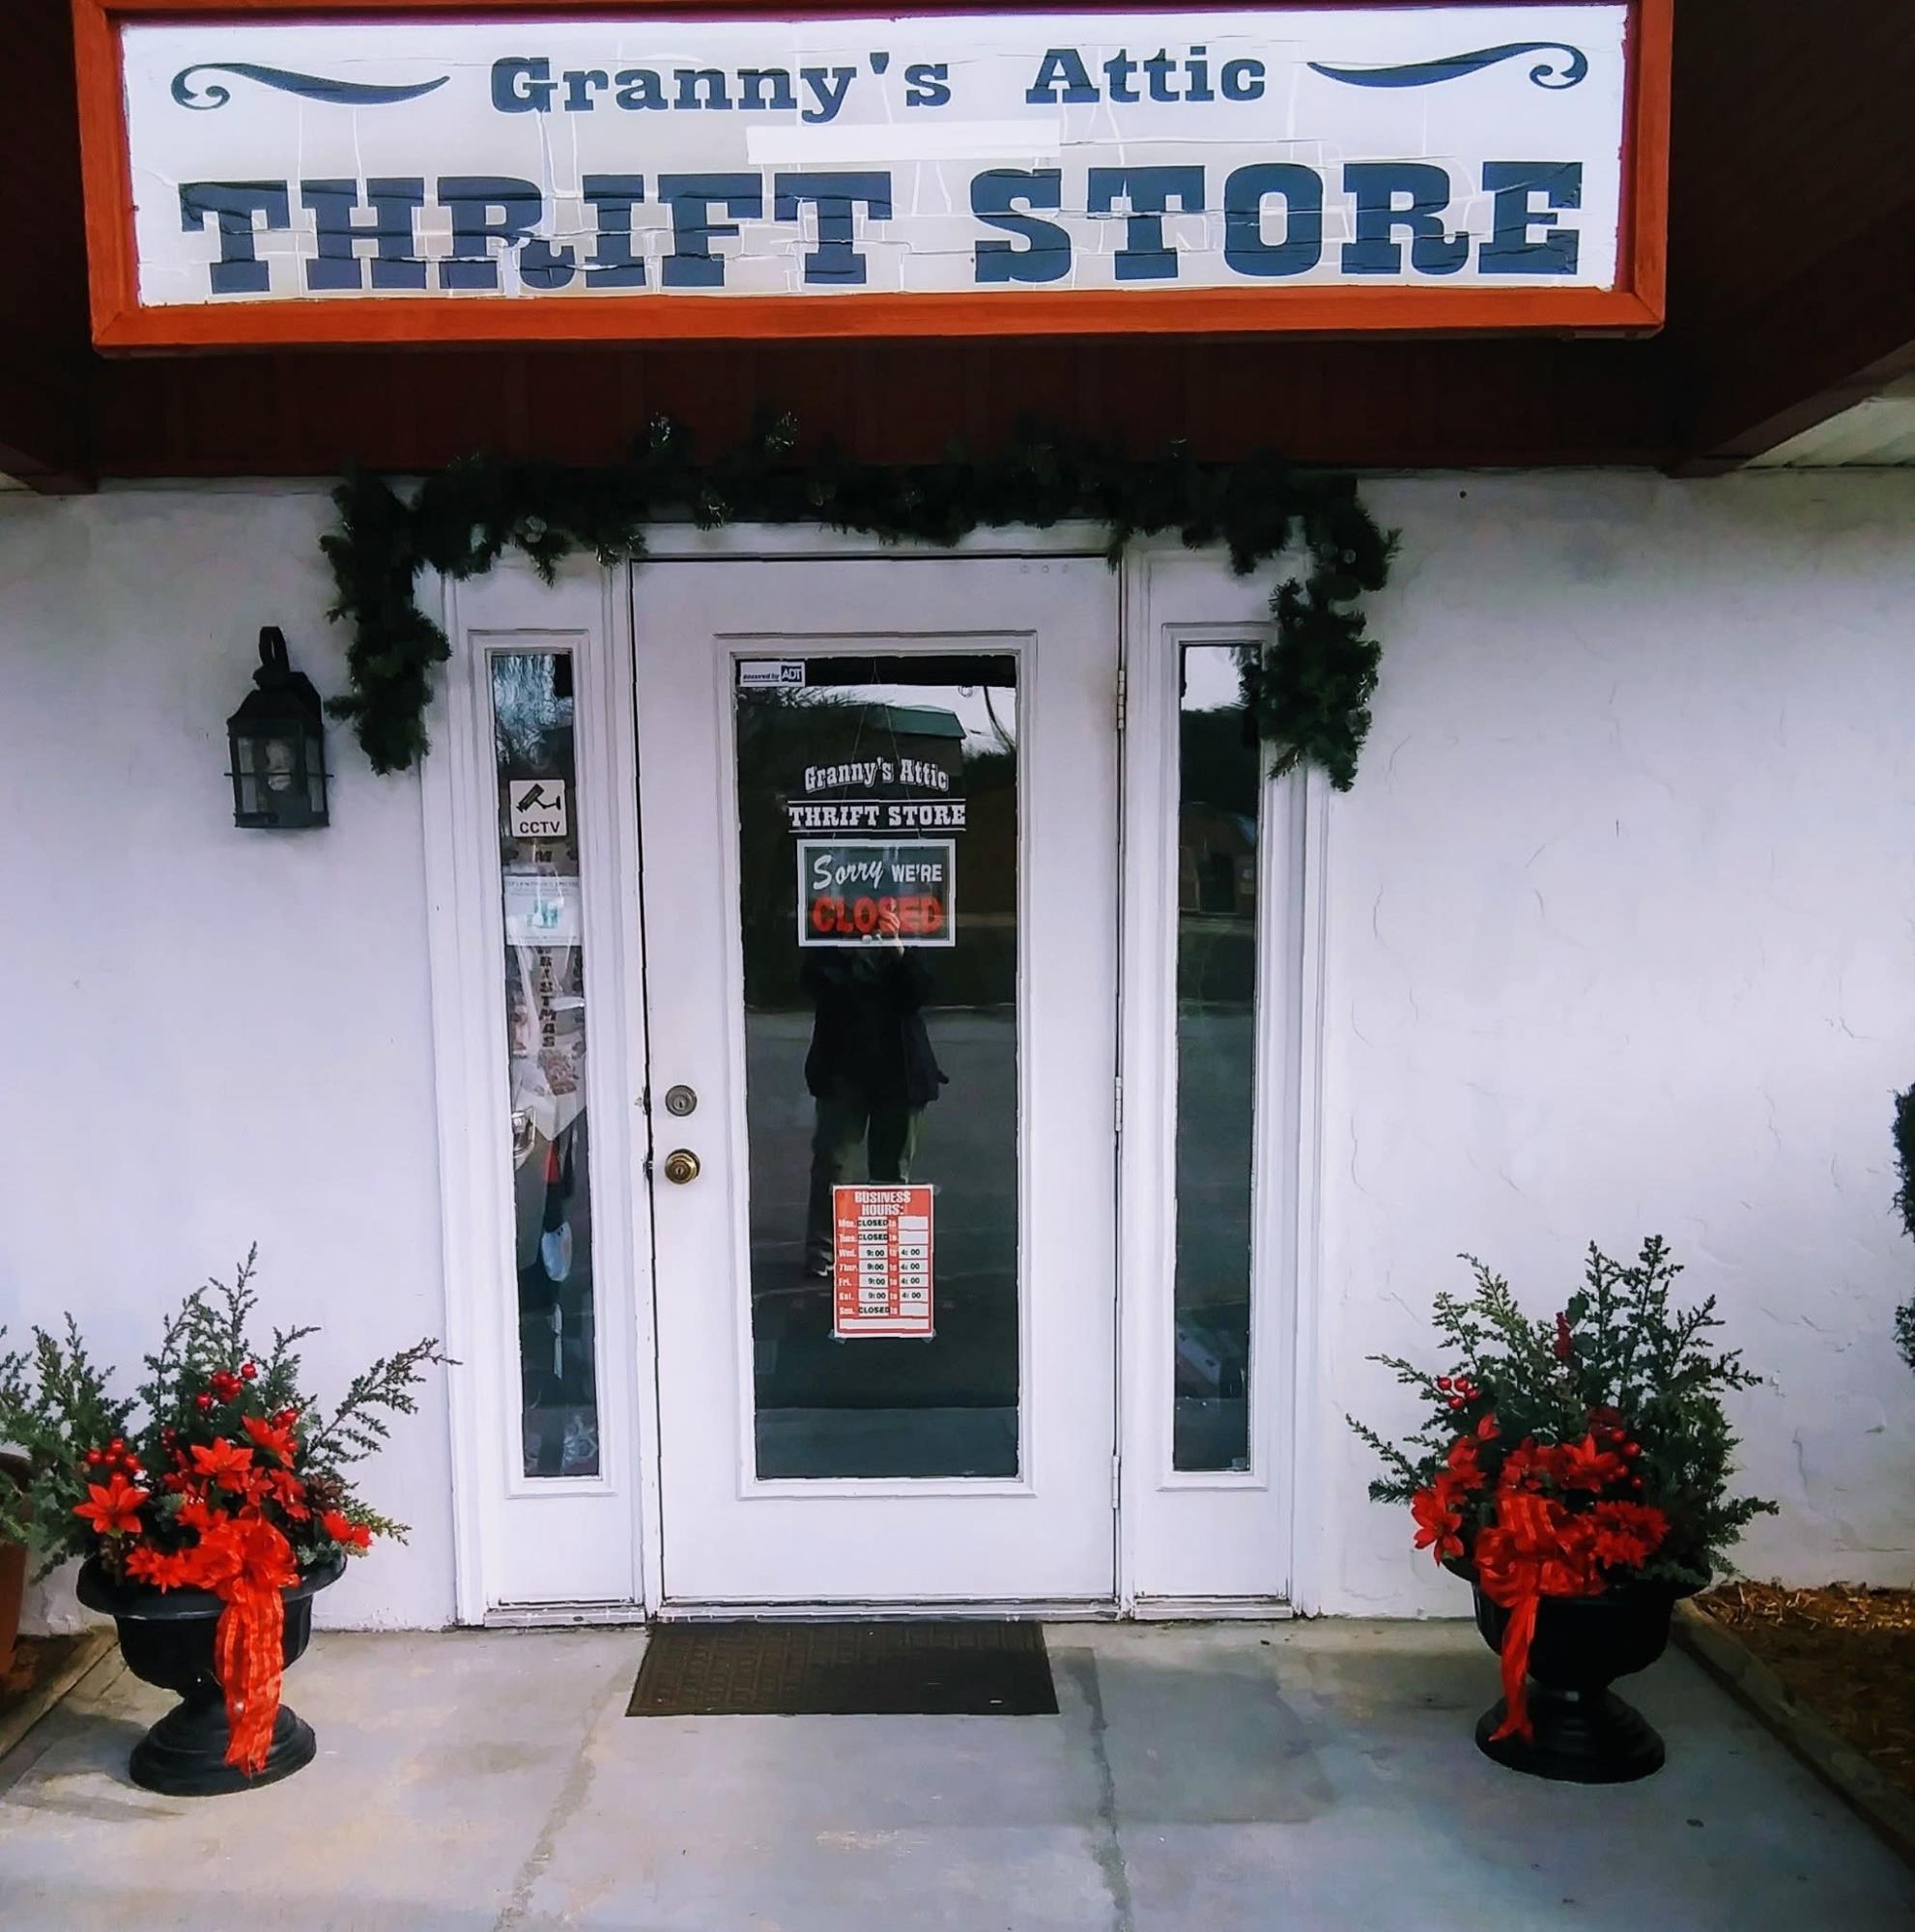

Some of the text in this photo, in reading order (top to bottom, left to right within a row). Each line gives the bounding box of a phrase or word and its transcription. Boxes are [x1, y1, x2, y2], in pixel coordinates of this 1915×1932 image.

[491, 46, 1266, 124] Granny's Attic
[179, 161, 1584, 295] THRIFT STORE
[782, 667, 801, 681] ADT
[805, 756, 949, 793] Granny's Attic
[520, 821, 560, 834] CCTV
[788, 805, 965, 828] THRIFT STORE
[814, 854, 942, 890] Sorry WE'RE
[812, 896, 944, 934] CLOSED
[854, 1191, 911, 1204] BUSINESS
[861, 1204, 904, 1215] HOURS:
